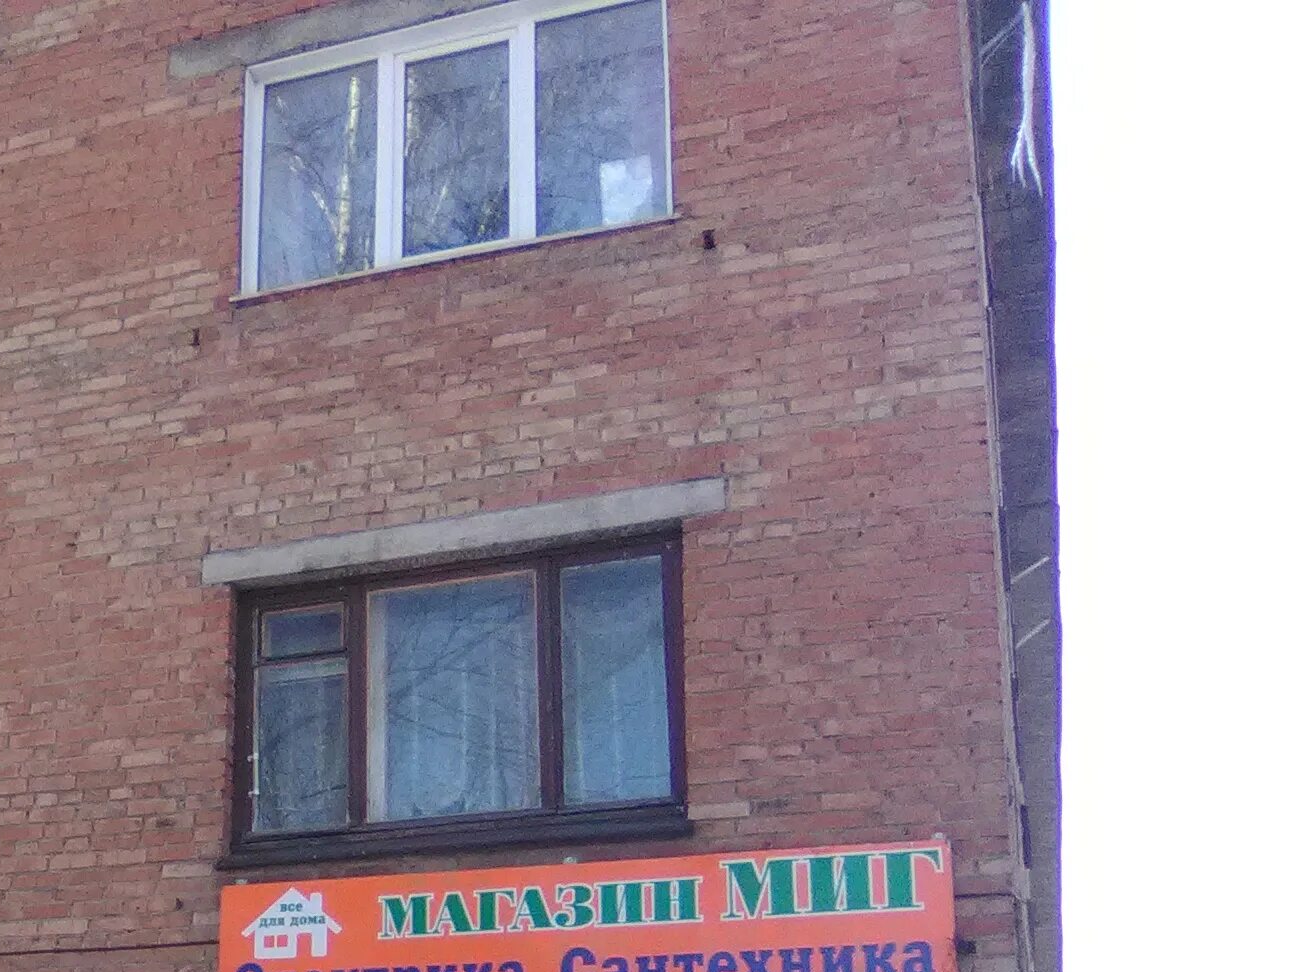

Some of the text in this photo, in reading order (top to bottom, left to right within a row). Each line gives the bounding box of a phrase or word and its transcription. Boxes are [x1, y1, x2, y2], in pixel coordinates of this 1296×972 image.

[378, 849, 944, 938] МАГАЗИН МИГ
[280, 903, 303, 912] все
[259, 915, 326, 928] для дома
